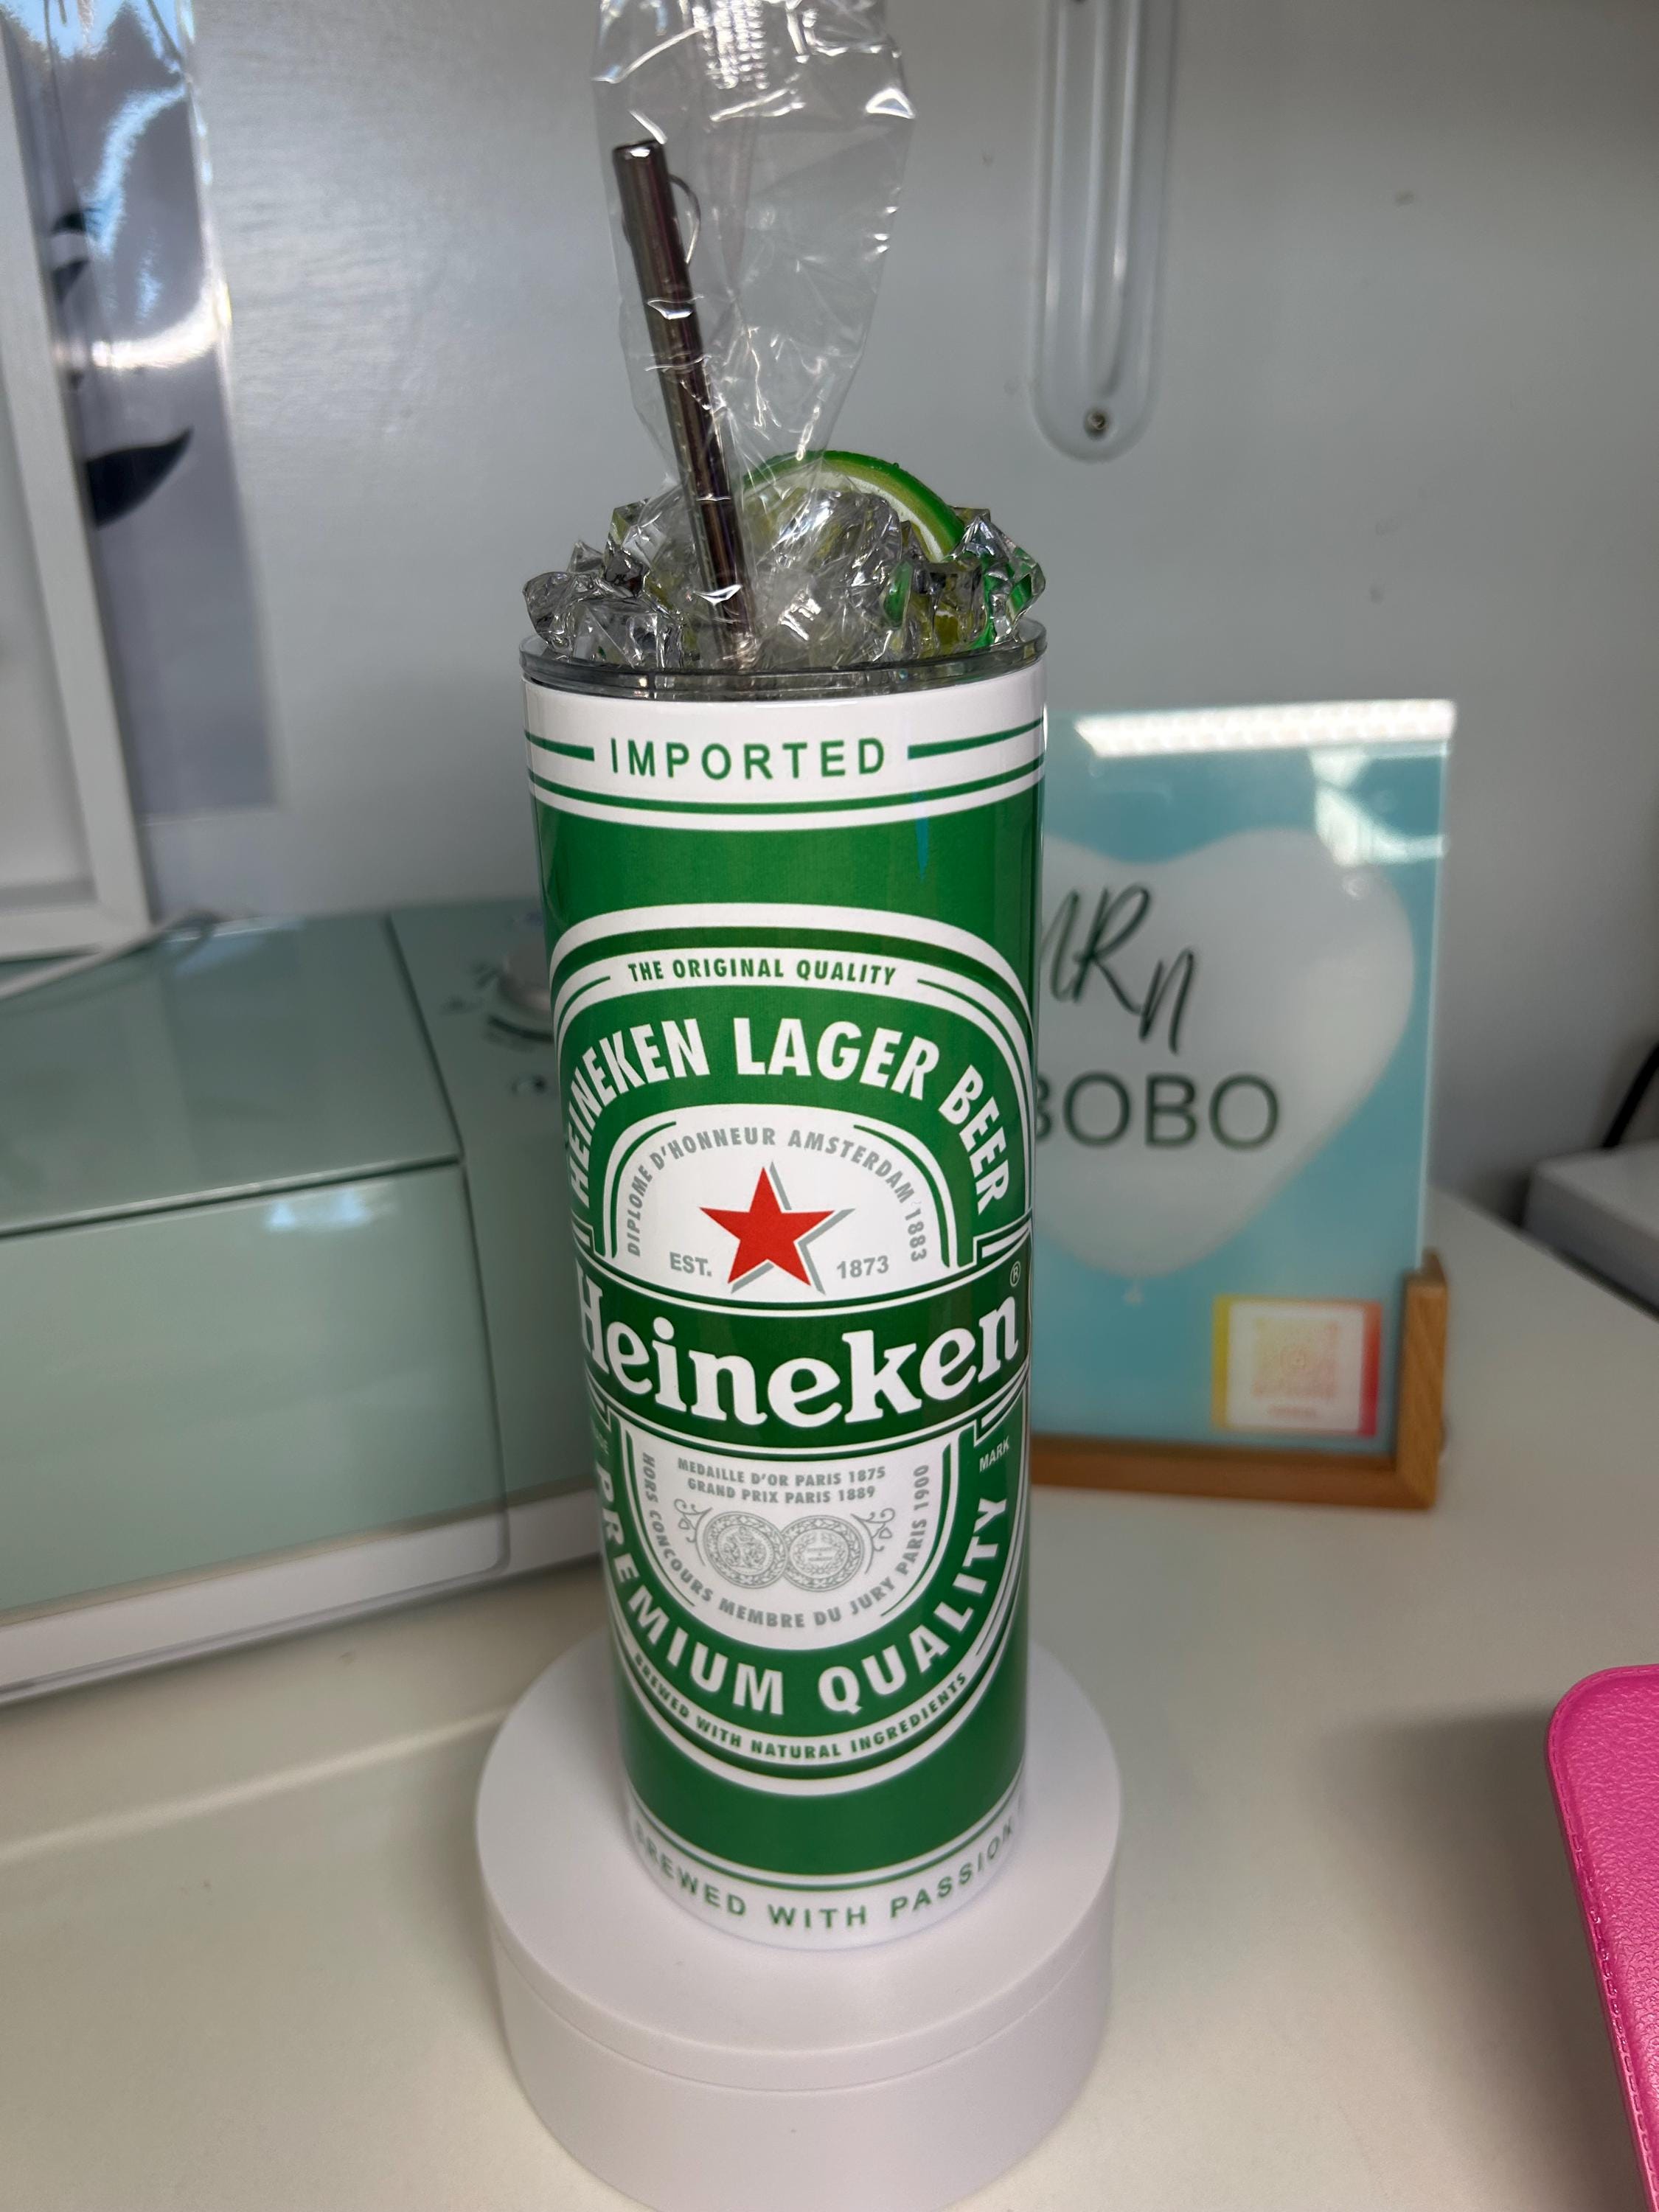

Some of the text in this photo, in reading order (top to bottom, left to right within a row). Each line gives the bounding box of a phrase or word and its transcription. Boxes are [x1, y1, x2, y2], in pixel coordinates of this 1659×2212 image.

[611, 737, 884, 780] IMPORTED
[627, 958, 897, 985] THE ORIGINAL QUALITY
[568, 1017, 1010, 1215] HEINEKEN LAGER BEER
[627, 1127, 927, 1262] DIPLOME D'HONNEUR AMSTERDAM 1883
[669, 1252, 713, 1277] EST.
[837, 1255, 889, 1279] 1873
[576, 1259, 1019, 1428] Heineken
[678, 1457, 886, 1486] MEDAILLE D'OR PARIS 1875
[978, 1436, 1010, 1474] MARK
[687, 1478, 876, 1504] GRAND PRIX PARIS 1889
[642, 1452, 930, 1628] HORS CONCOURS MEMBRE DU JURY PARIS 1900
[596, 1461, 1007, 1716] PREMIUM QUALITY
[695, 1714, 742, 1748] WITH
[751, 1739, 842, 1759] NATURAL
[850, 1672, 967, 1754] INGREDIENTS
[767, 1904, 866, 1929] WITH
